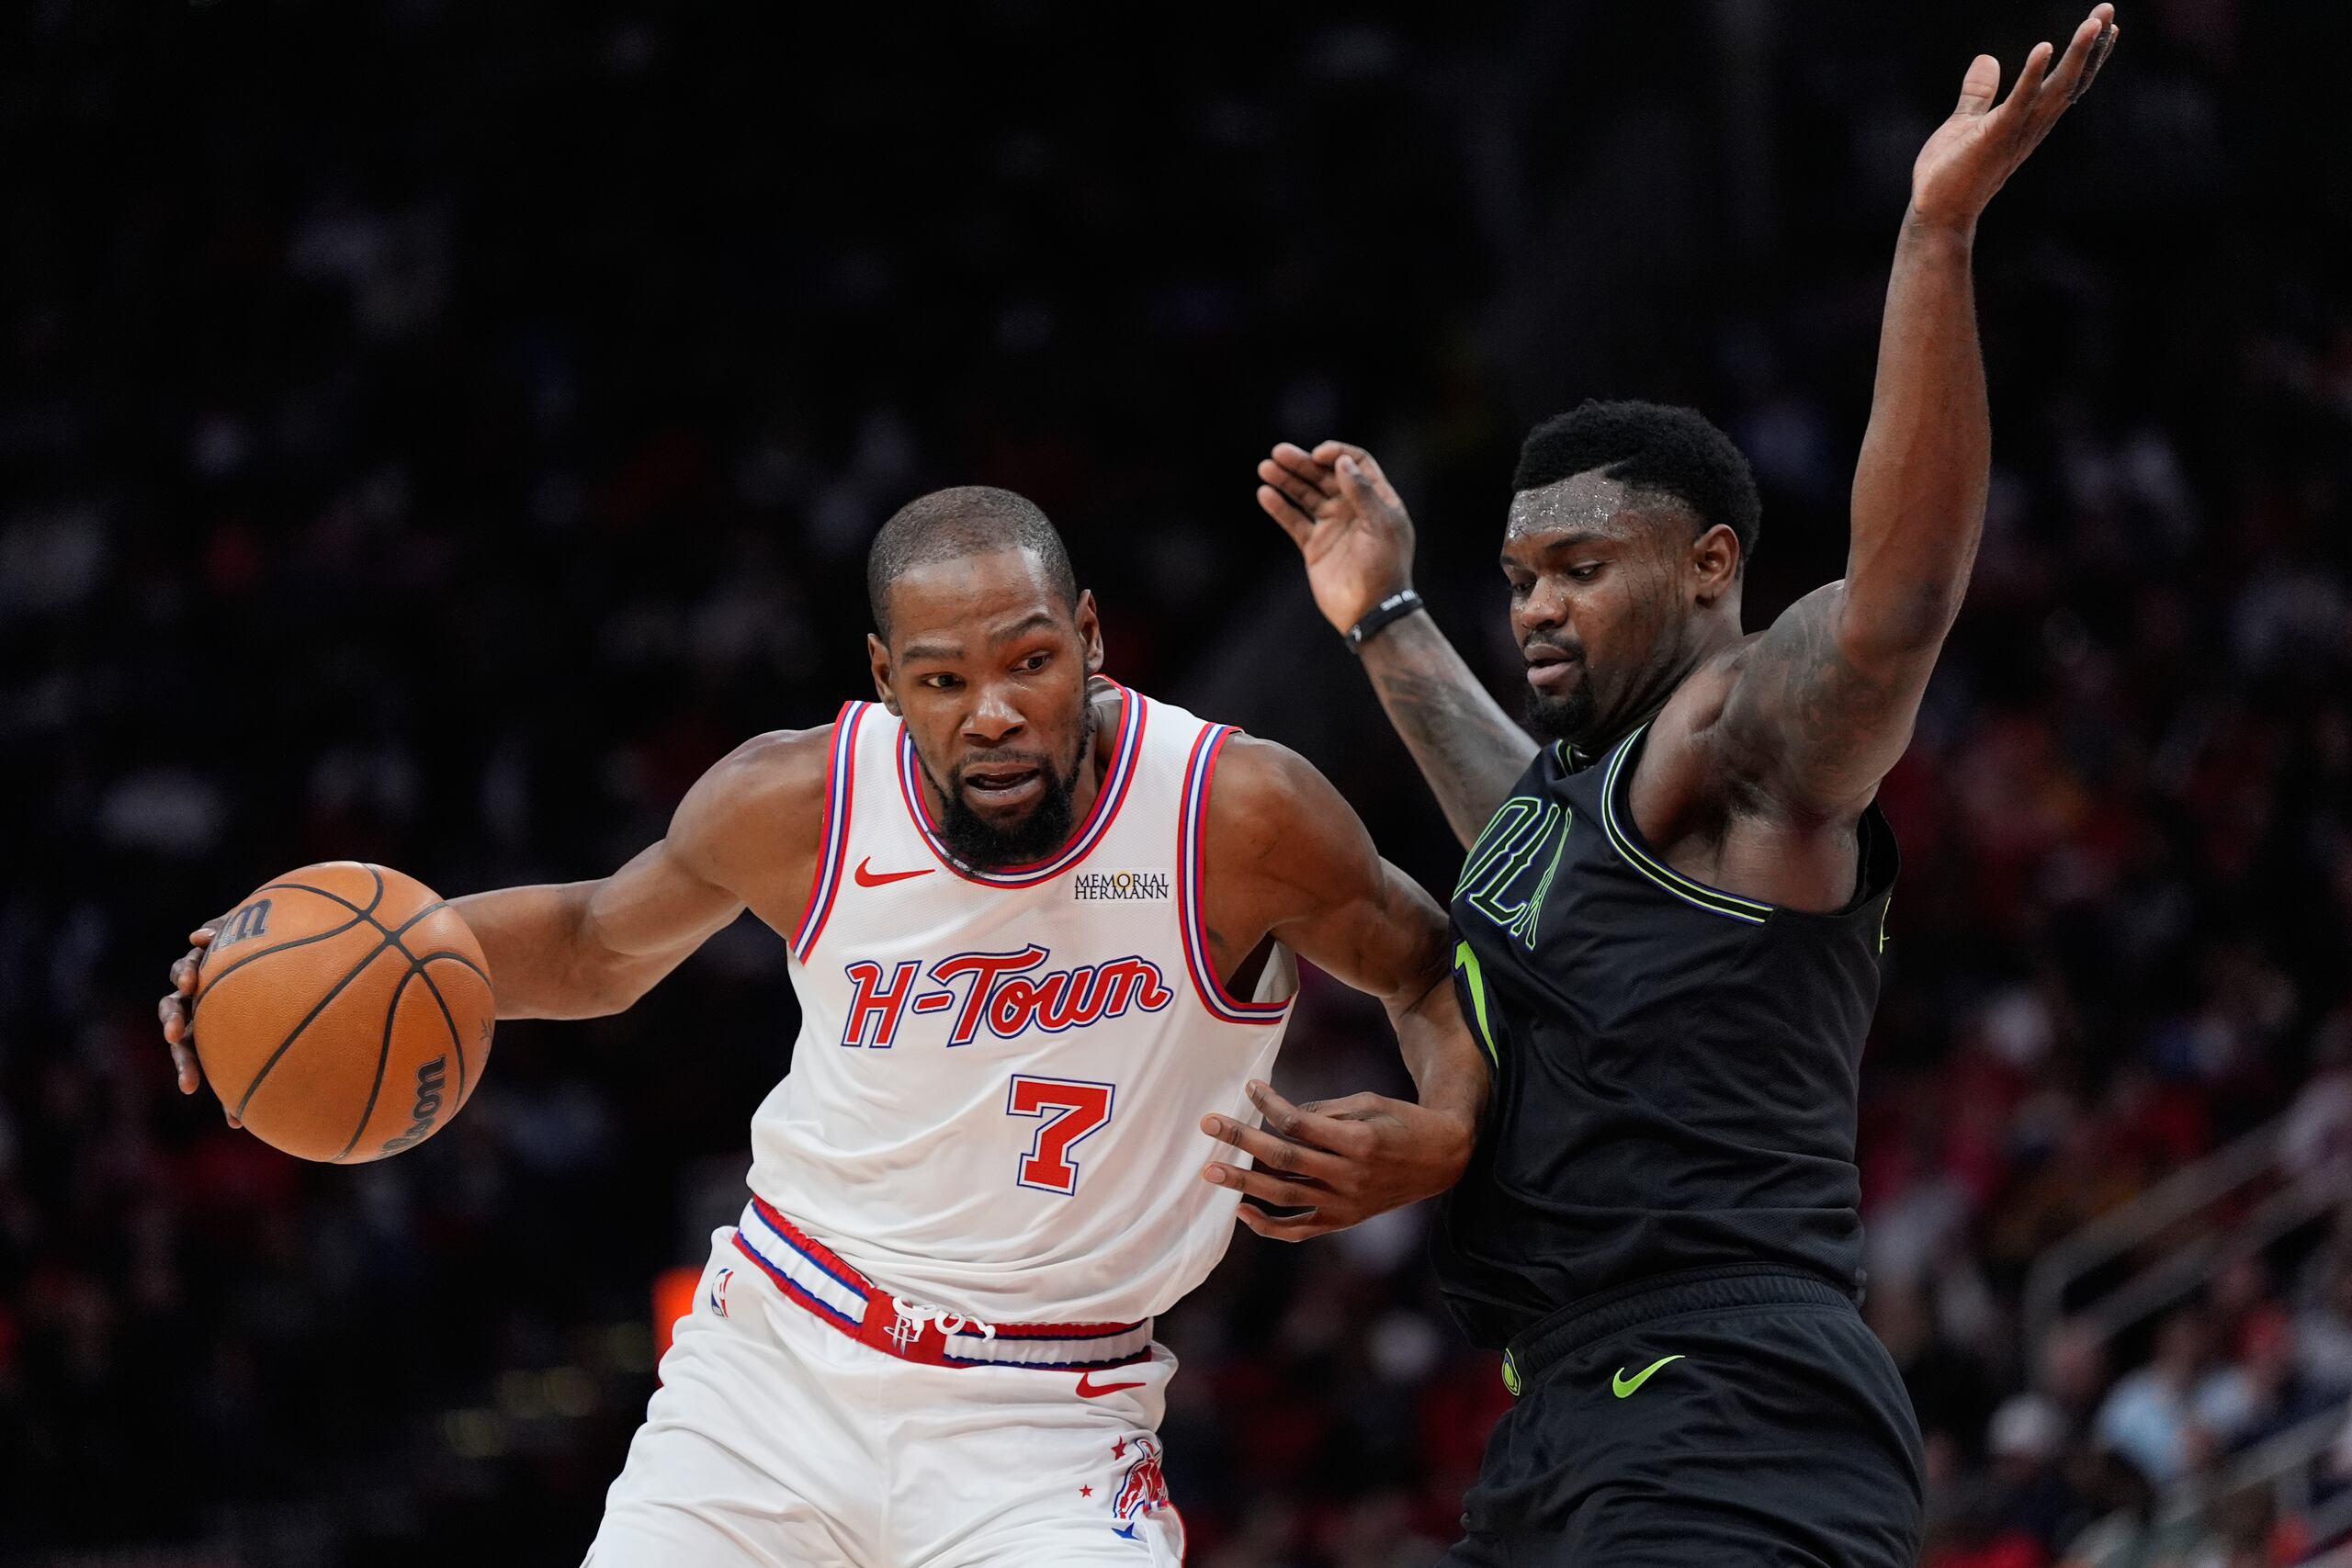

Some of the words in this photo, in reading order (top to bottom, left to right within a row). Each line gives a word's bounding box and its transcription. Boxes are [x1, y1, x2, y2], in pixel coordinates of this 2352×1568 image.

[1074, 874, 1169, 887] MEMORIAL
[1074, 886, 1169, 899] HERMANN
[841, 942, 1174, 1049] H-Town
[1006, 1074, 1115, 1197] 7
